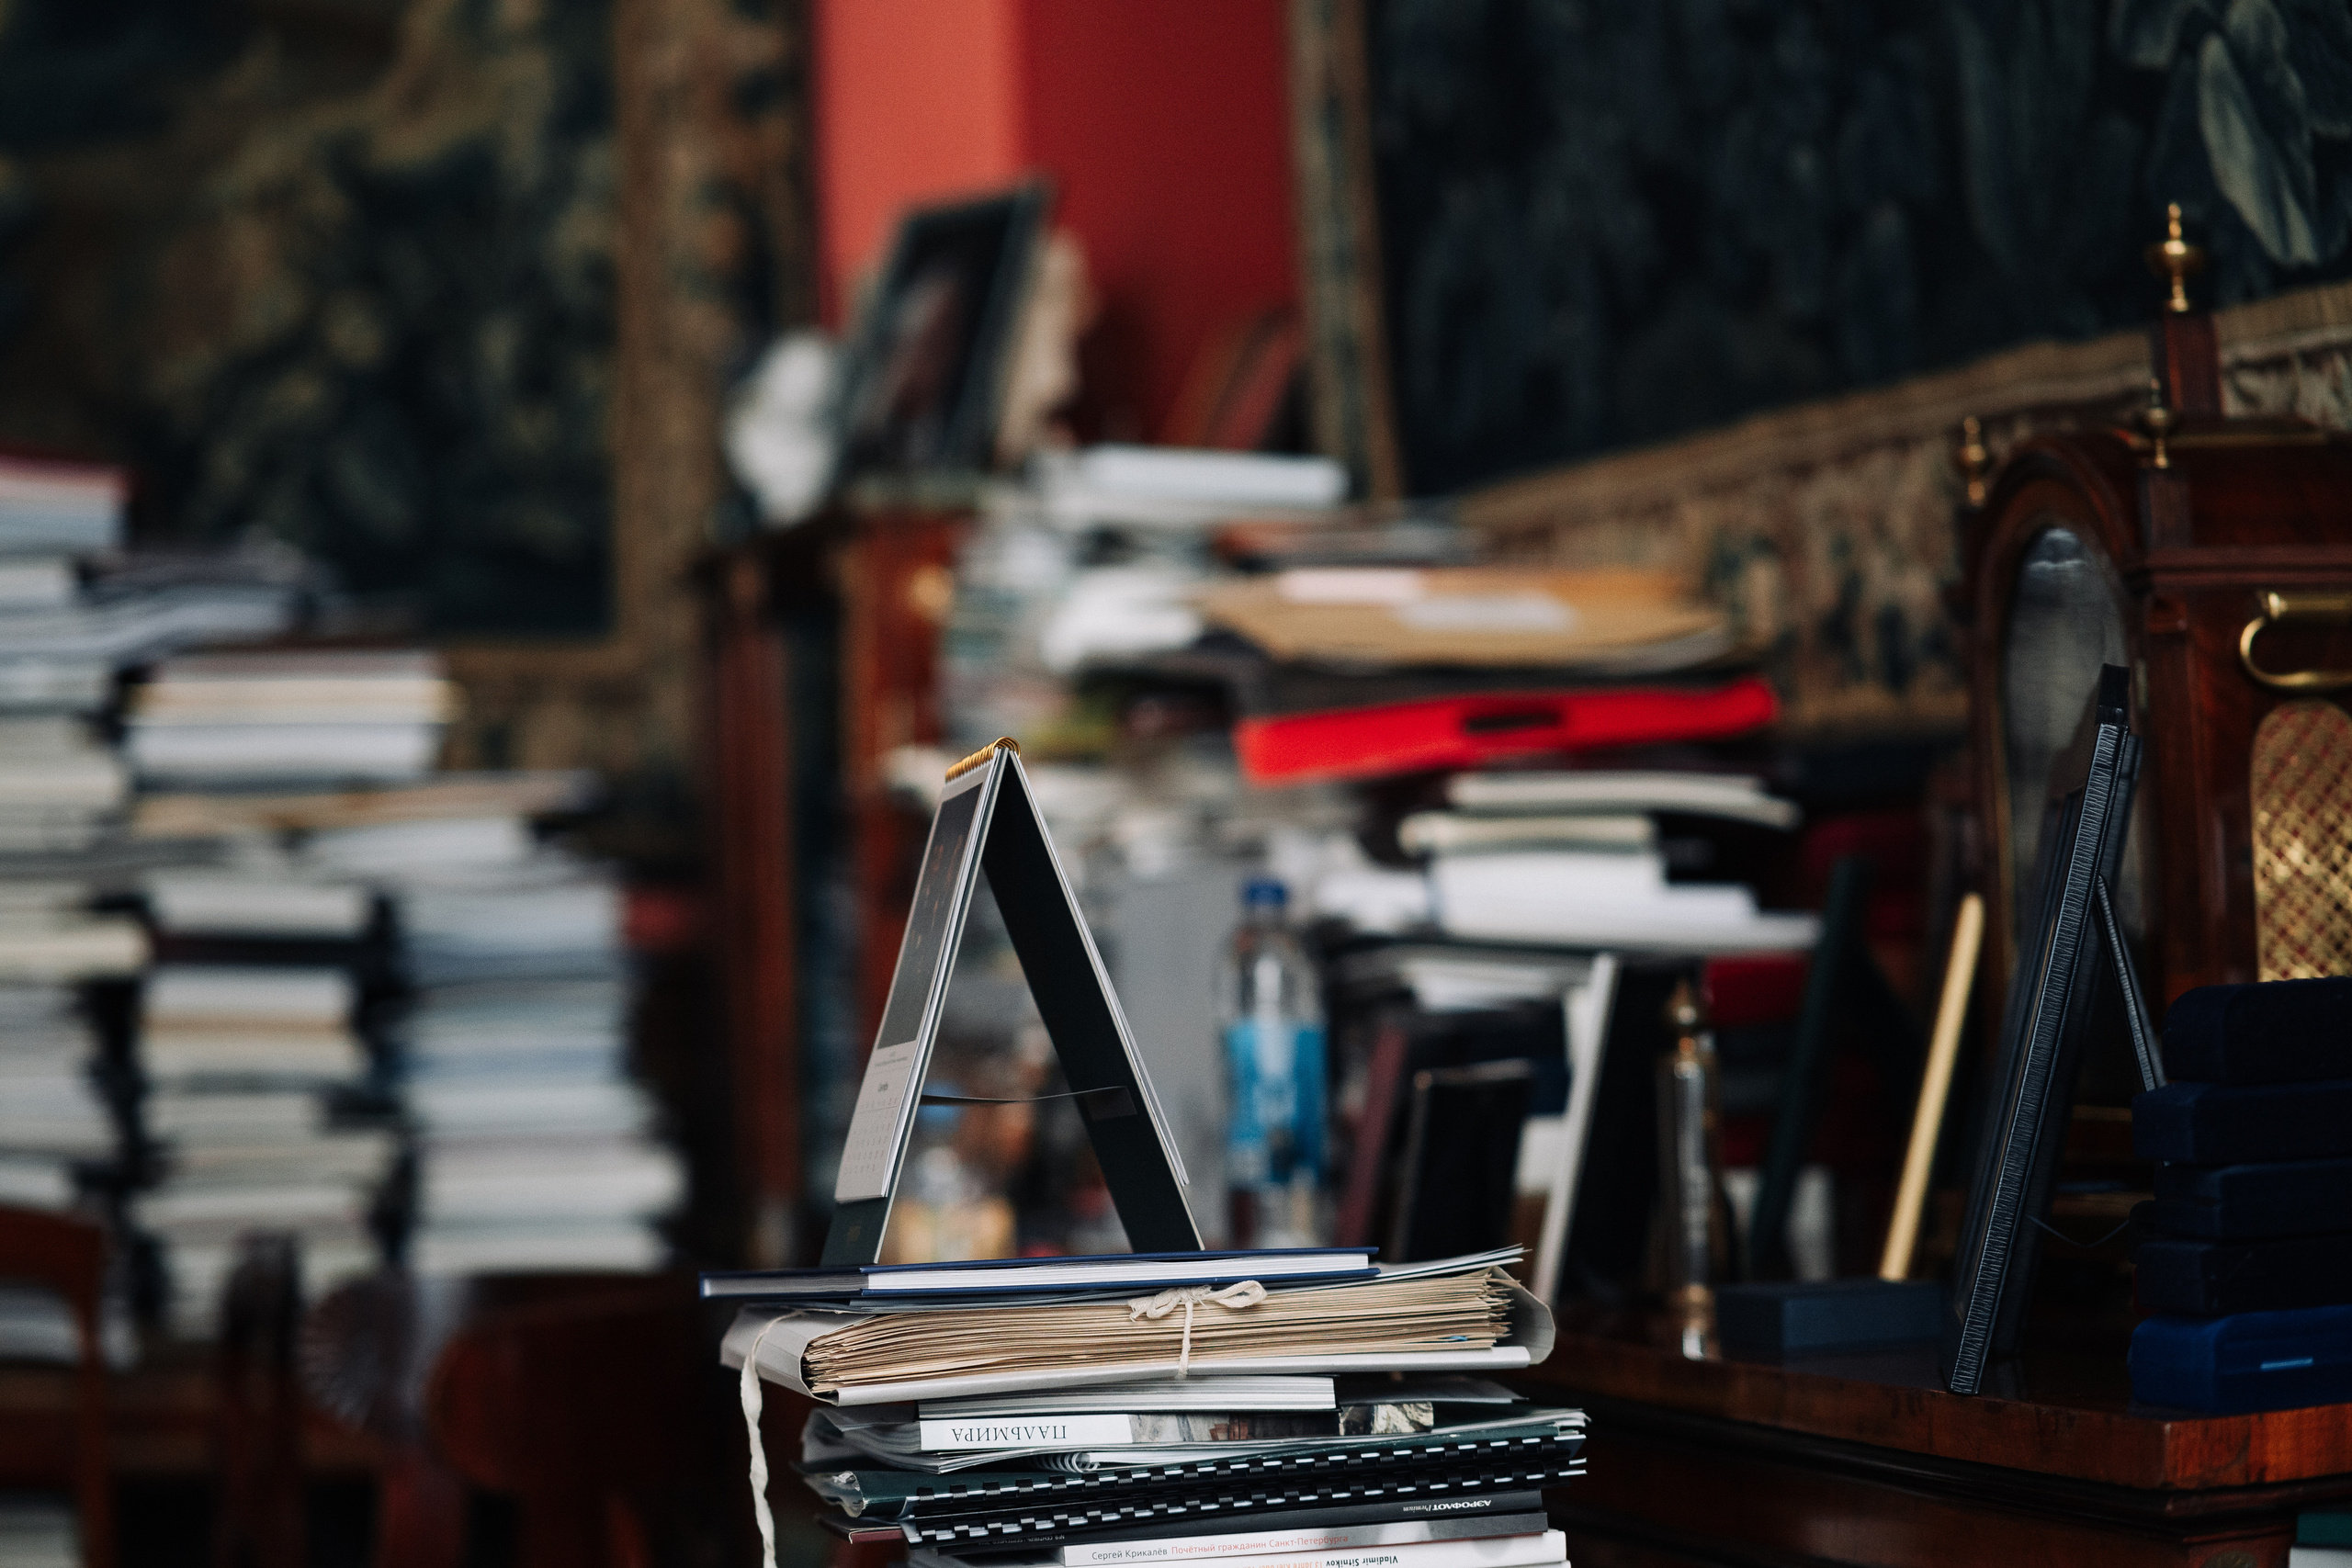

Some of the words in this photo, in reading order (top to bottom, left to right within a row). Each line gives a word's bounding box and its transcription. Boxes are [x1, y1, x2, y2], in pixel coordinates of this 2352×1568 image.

[951, 1425, 1068, 1442] ПАЛЬМИРА
[1403, 1504, 1431, 1513] Premium
[1431, 1499, 1492, 1512] АЭРОФЛОТ
[1091, 1550, 1123, 1561] Сергей
[1125, 1548, 1168, 1559] Крикалёв
[1171, 1543, 1216, 1555] Почётный
[1217, 1542, 1267, 1552] гражданин
[1269, 1535, 1349, 1547] Санкт-Петербурга
[1326, 1557, 1360, 1567] Sitnikov
[1362, 1555, 1398, 1565] Vladimir
